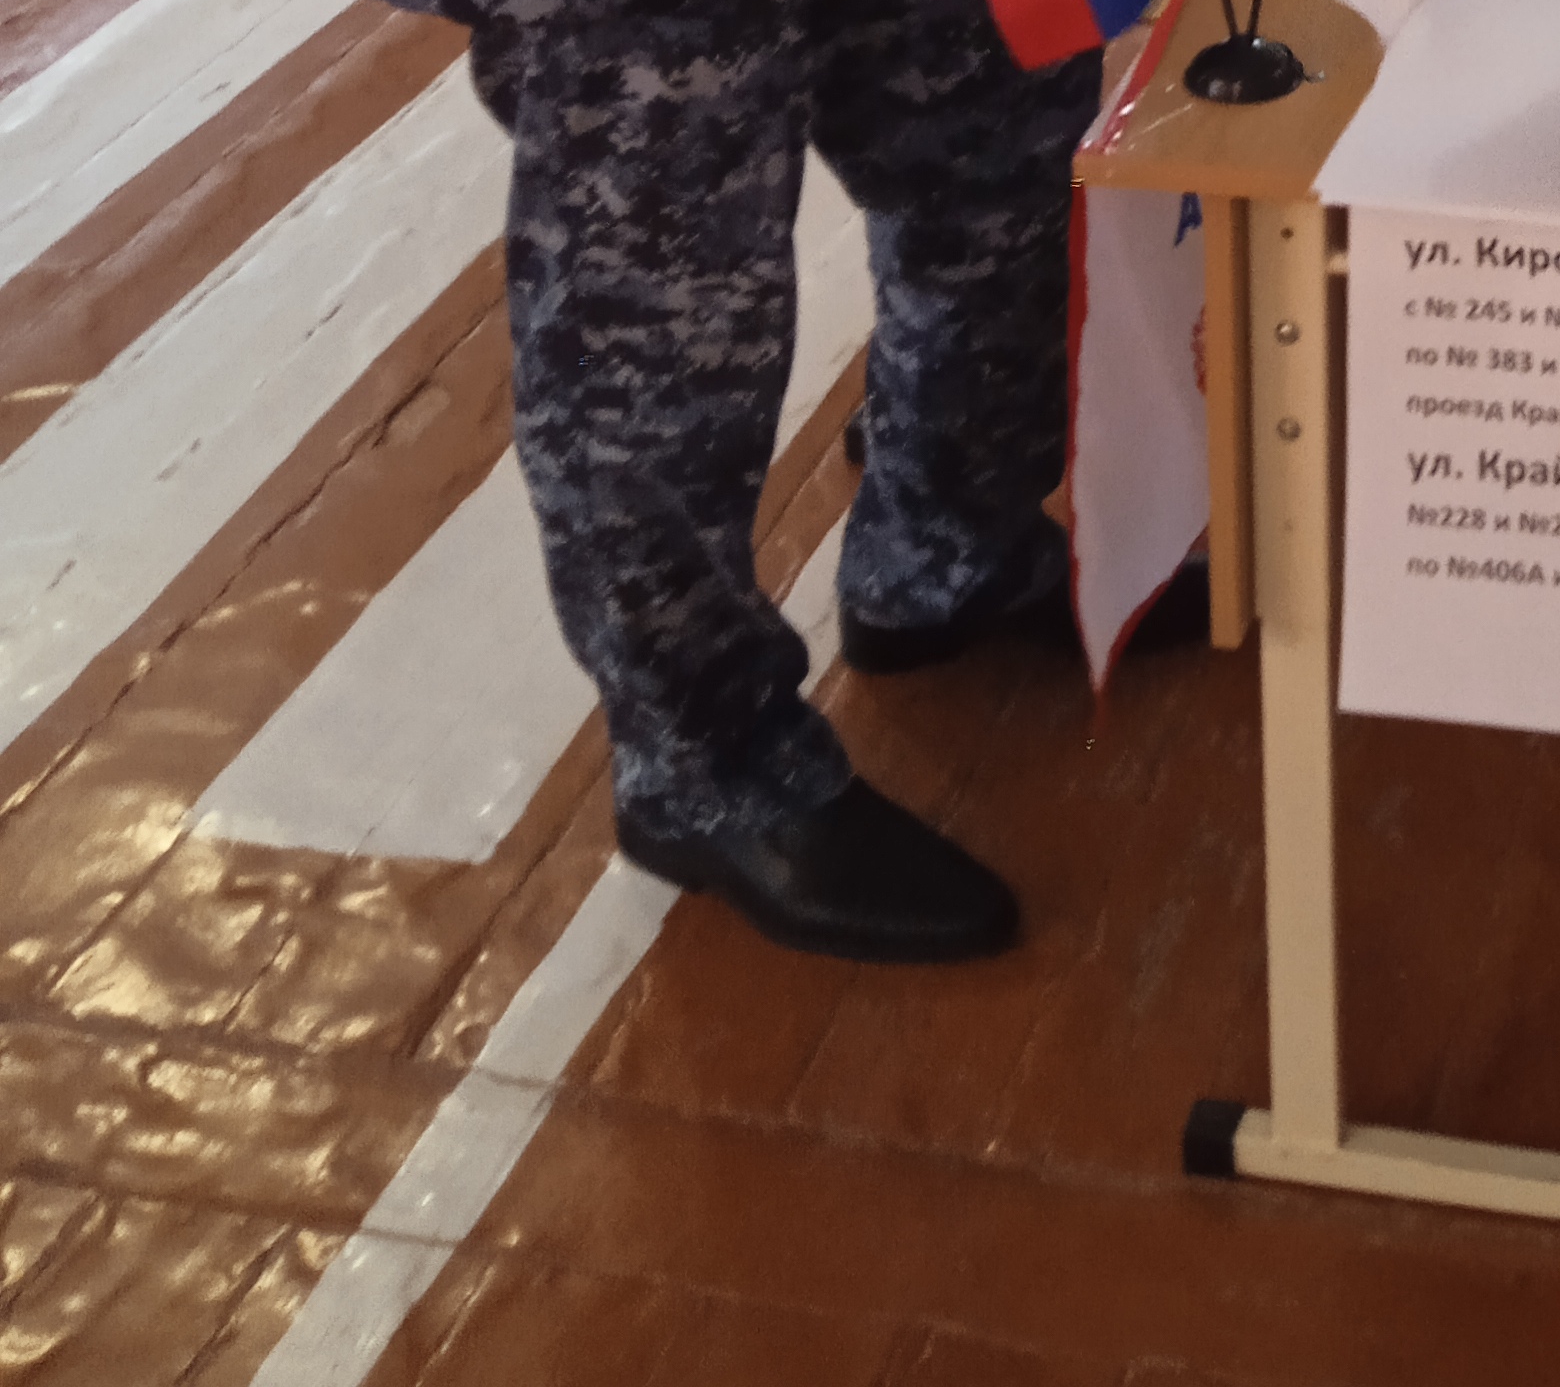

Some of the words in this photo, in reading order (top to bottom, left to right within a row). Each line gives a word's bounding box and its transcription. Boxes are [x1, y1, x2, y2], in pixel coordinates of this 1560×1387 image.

[1404, 239, 1461, 270] ул.
[1403, 299, 1417, 317] с
[1424, 296, 1457, 320] №
[1465, 298, 1512, 324] 245
[1520, 306, 1536, 325] и
[1405, 346, 1439, 367] по
[1445, 345, 1478, 368] №
[1487, 347, 1533, 374] 383
[1540, 357, 1557, 376] и
[1405, 394, 1503, 423] проезд
[1407, 449, 1464, 484] ул.
[1407, 503, 1487, 530] №228
[1494, 513, 1511, 532] и
[1406, 556, 1440, 577] по
[1447, 555, 1546, 584] №406А
